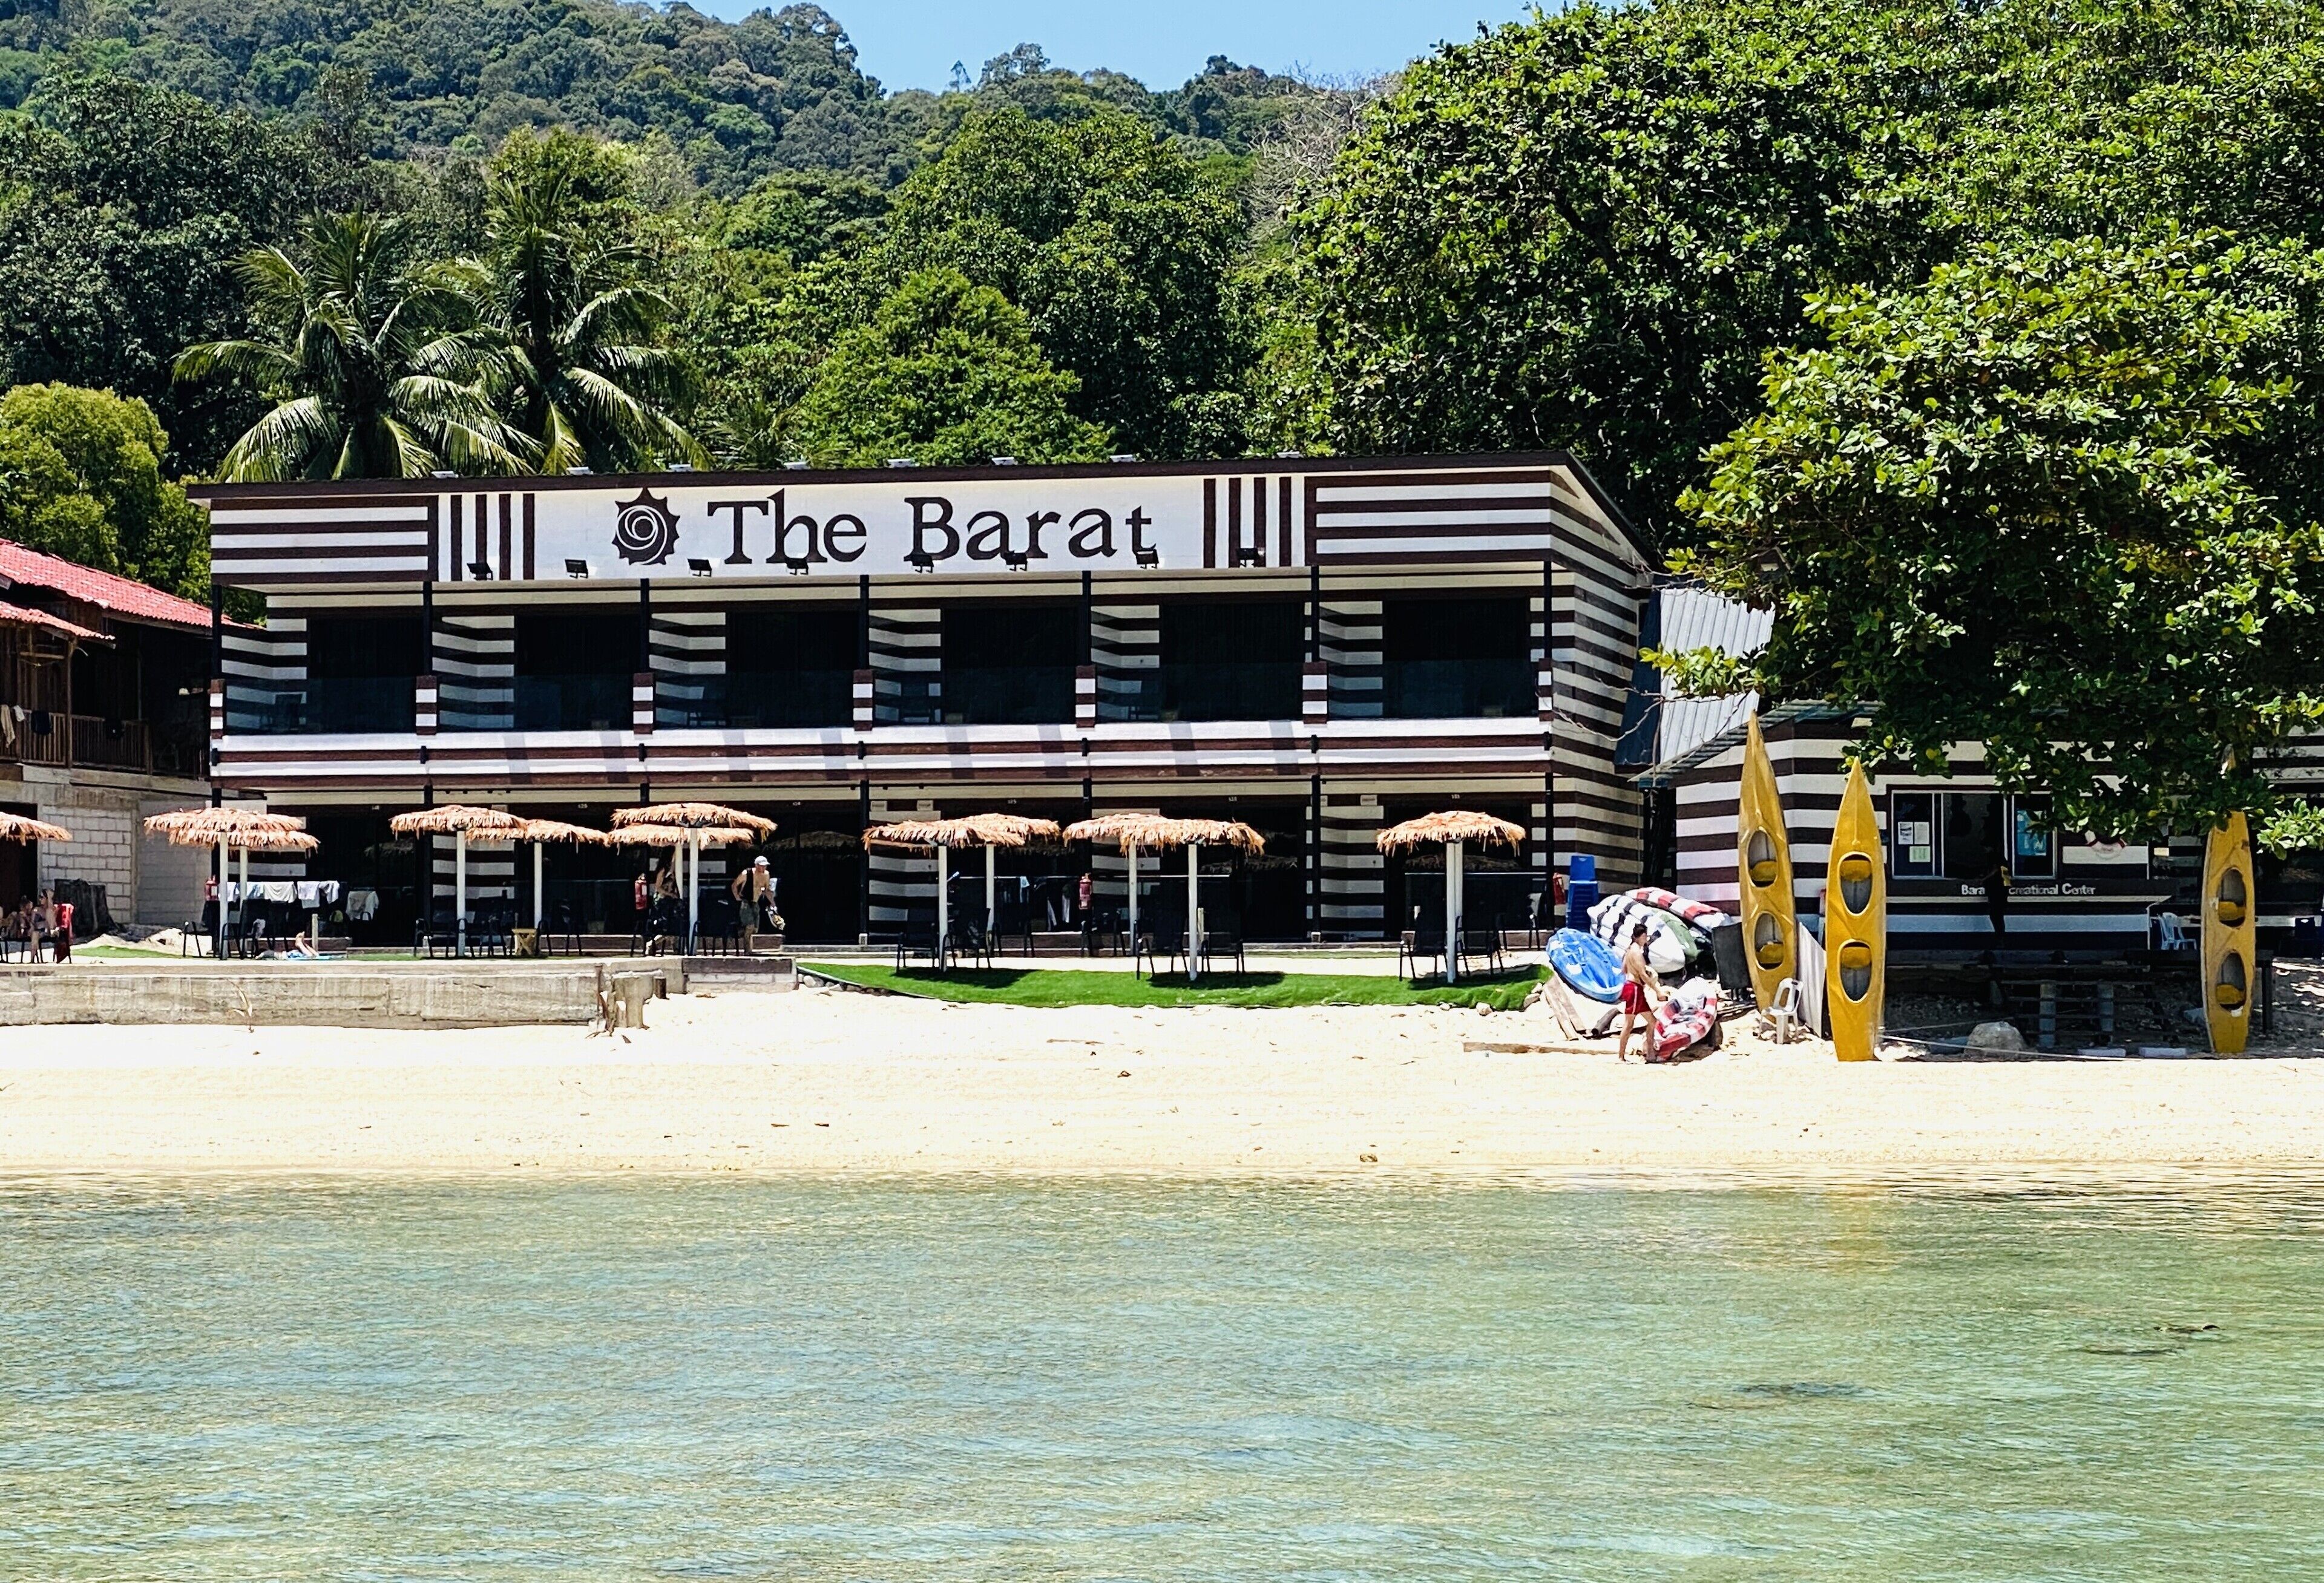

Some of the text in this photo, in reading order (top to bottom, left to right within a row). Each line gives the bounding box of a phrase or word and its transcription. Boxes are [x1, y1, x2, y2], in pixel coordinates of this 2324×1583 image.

[707, 488, 1157, 564] The Barat
[1961, 883, 2096, 895] Bara creational Center
